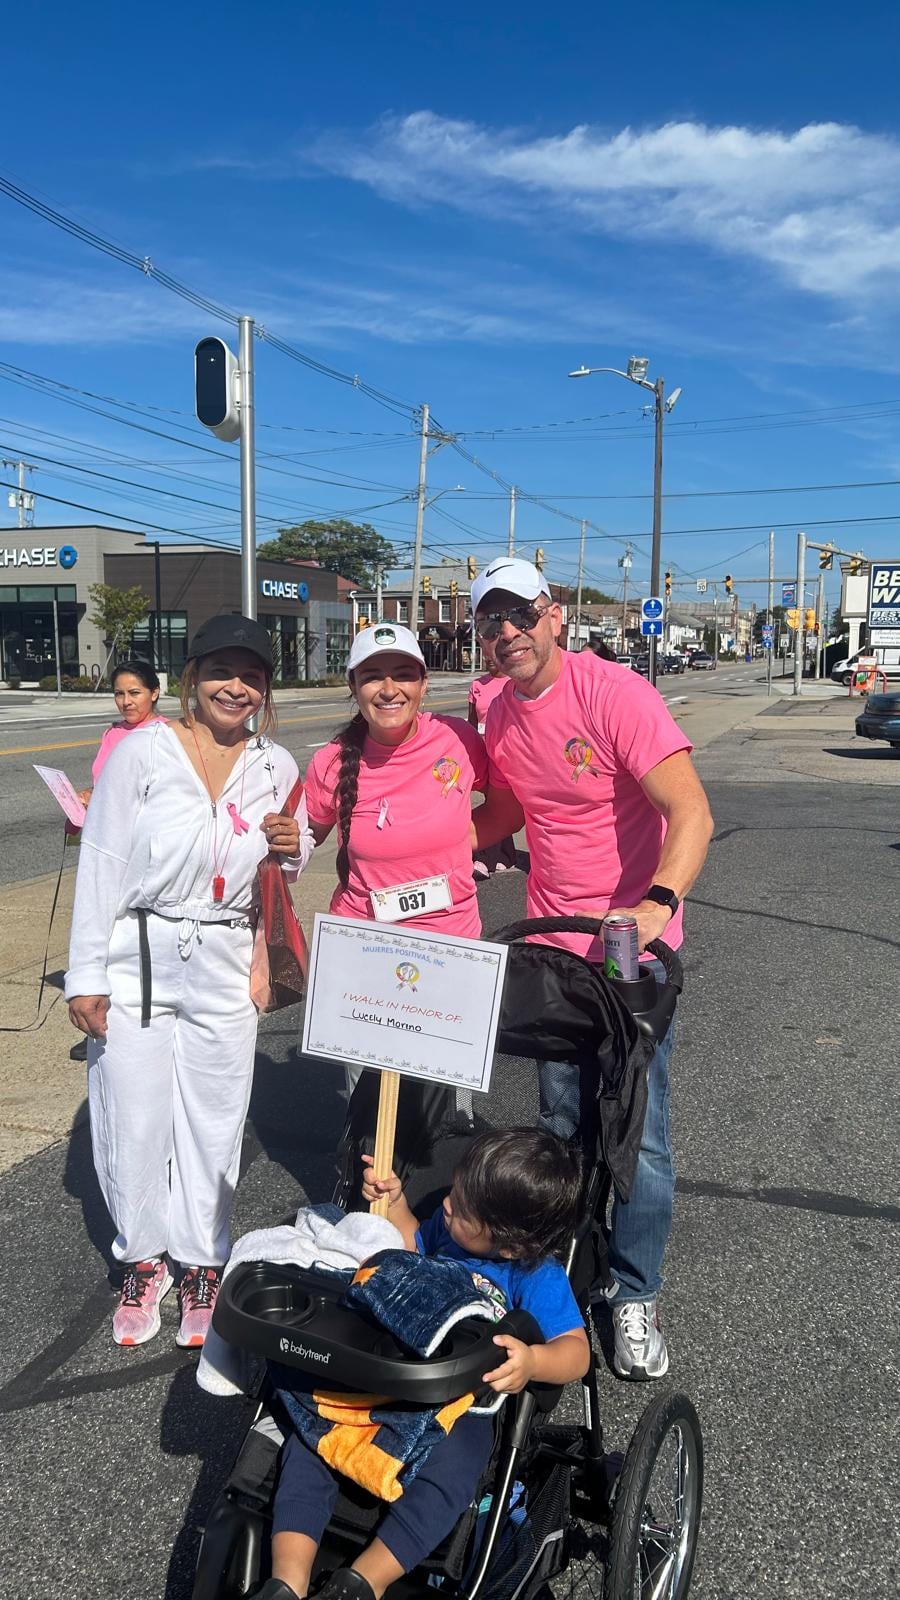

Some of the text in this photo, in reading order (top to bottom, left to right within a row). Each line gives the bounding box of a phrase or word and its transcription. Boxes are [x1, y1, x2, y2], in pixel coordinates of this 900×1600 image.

[262, 580, 298, 599] CHASE
[399, 892, 425, 912] 037
[362, 946, 446, 968] MUJERES POSITIVAS, INC
[343, 992, 347, 1000] I
[349, 996, 383, 1007] WALK
[386, 1001, 398, 1009] IN
[402, 1004, 442, 1019] HONOR
[352, 1008, 382, 1025] Lucely
[290, 1340, 329, 1364] babytrend
